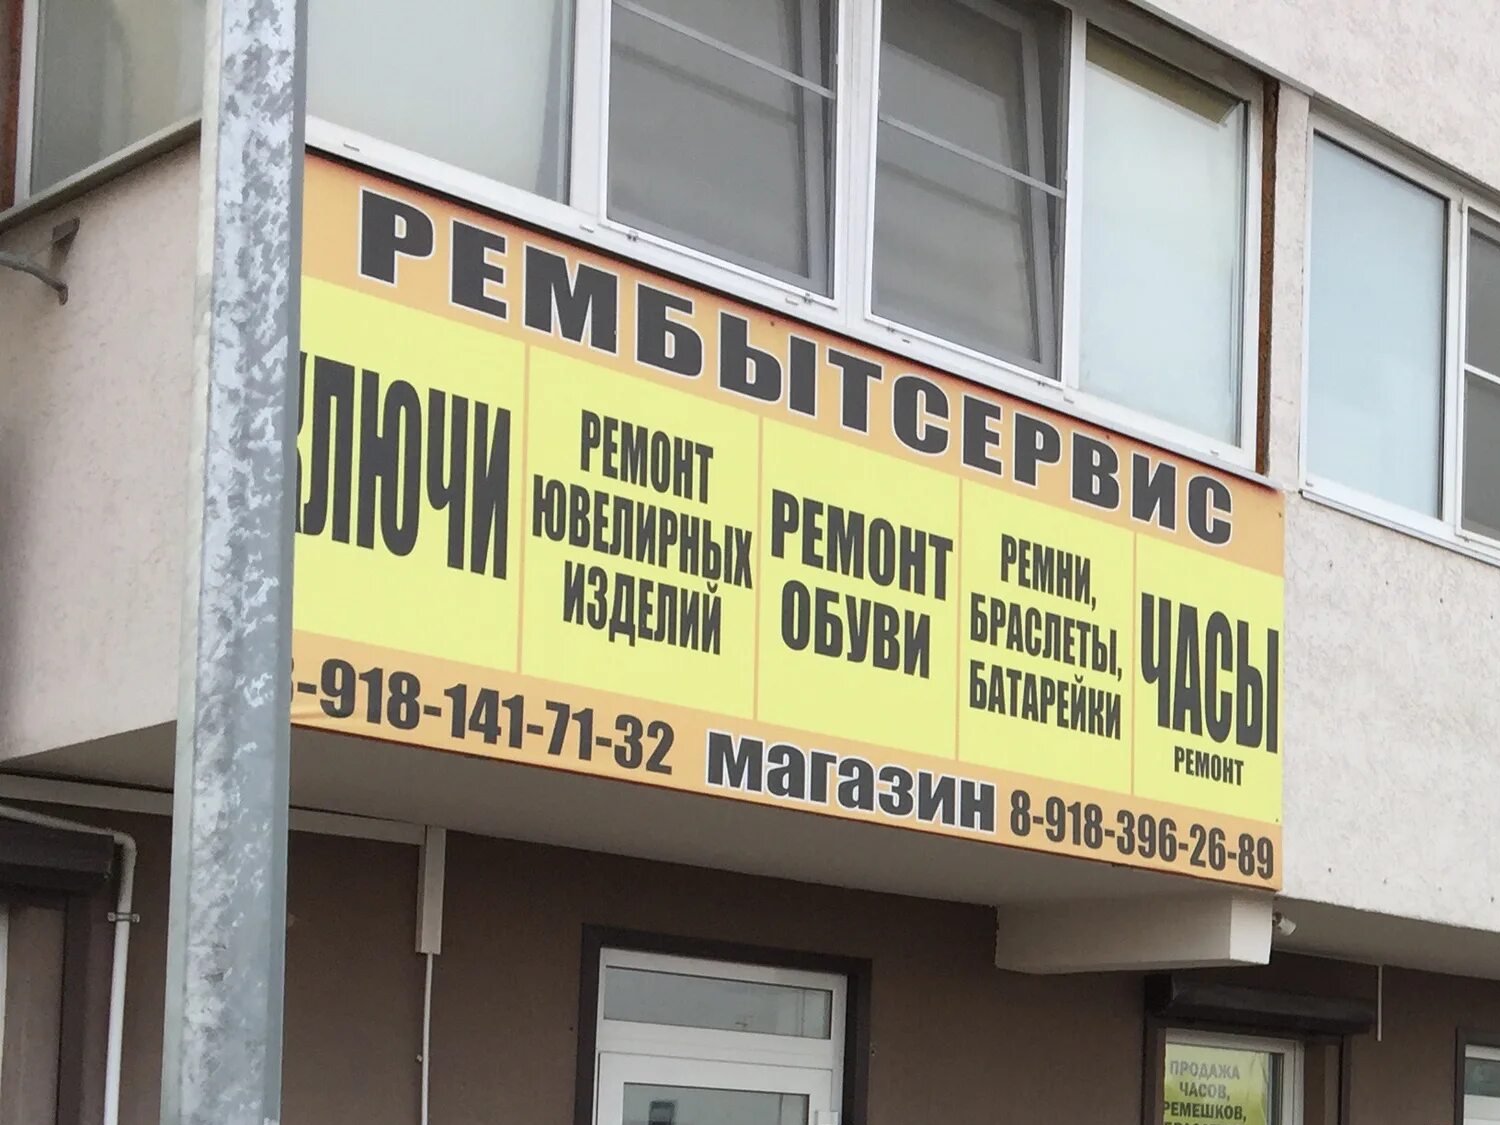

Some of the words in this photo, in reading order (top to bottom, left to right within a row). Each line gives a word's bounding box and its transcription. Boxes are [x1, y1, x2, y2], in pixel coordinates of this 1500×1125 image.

[357, 185, 1234, 546] РЕМБЫТСЕРВИС
[296, 351, 512, 581] ЛЮЧИ
[580, 408, 714, 504] РЕМОНТ
[532, 474, 753, 590] ЮВЕЛИРНЫХ
[770, 488, 954, 601] РЕМОНТ
[1000, 533, 1097, 611] РЕМНИ,
[563, 558, 722, 655] ИЗДЕЛИЙ
[780, 579, 931, 680] ОБУВИ
[969, 591, 1123, 682] БРАСЛЕТЫ,
[291, 657, 676, 776] -918-141-71-32
[968, 658, 1122, 741] БАТАРЕЙКИ
[1140, 591, 1279, 755] ЧАСЫ
[705, 730, 996, 834] магазин
[1173, 745, 1245, 787] РЕМОНТ
[1009, 789, 1276, 881] 8-918-396-26-89
[1164, 1101, 1247, 1122] РЕМЕШКОВ,
[1169, 1060, 1241, 1081] ПРОДАЖА
[1178, 1081, 1231, 1101] ЧАСОВ,
